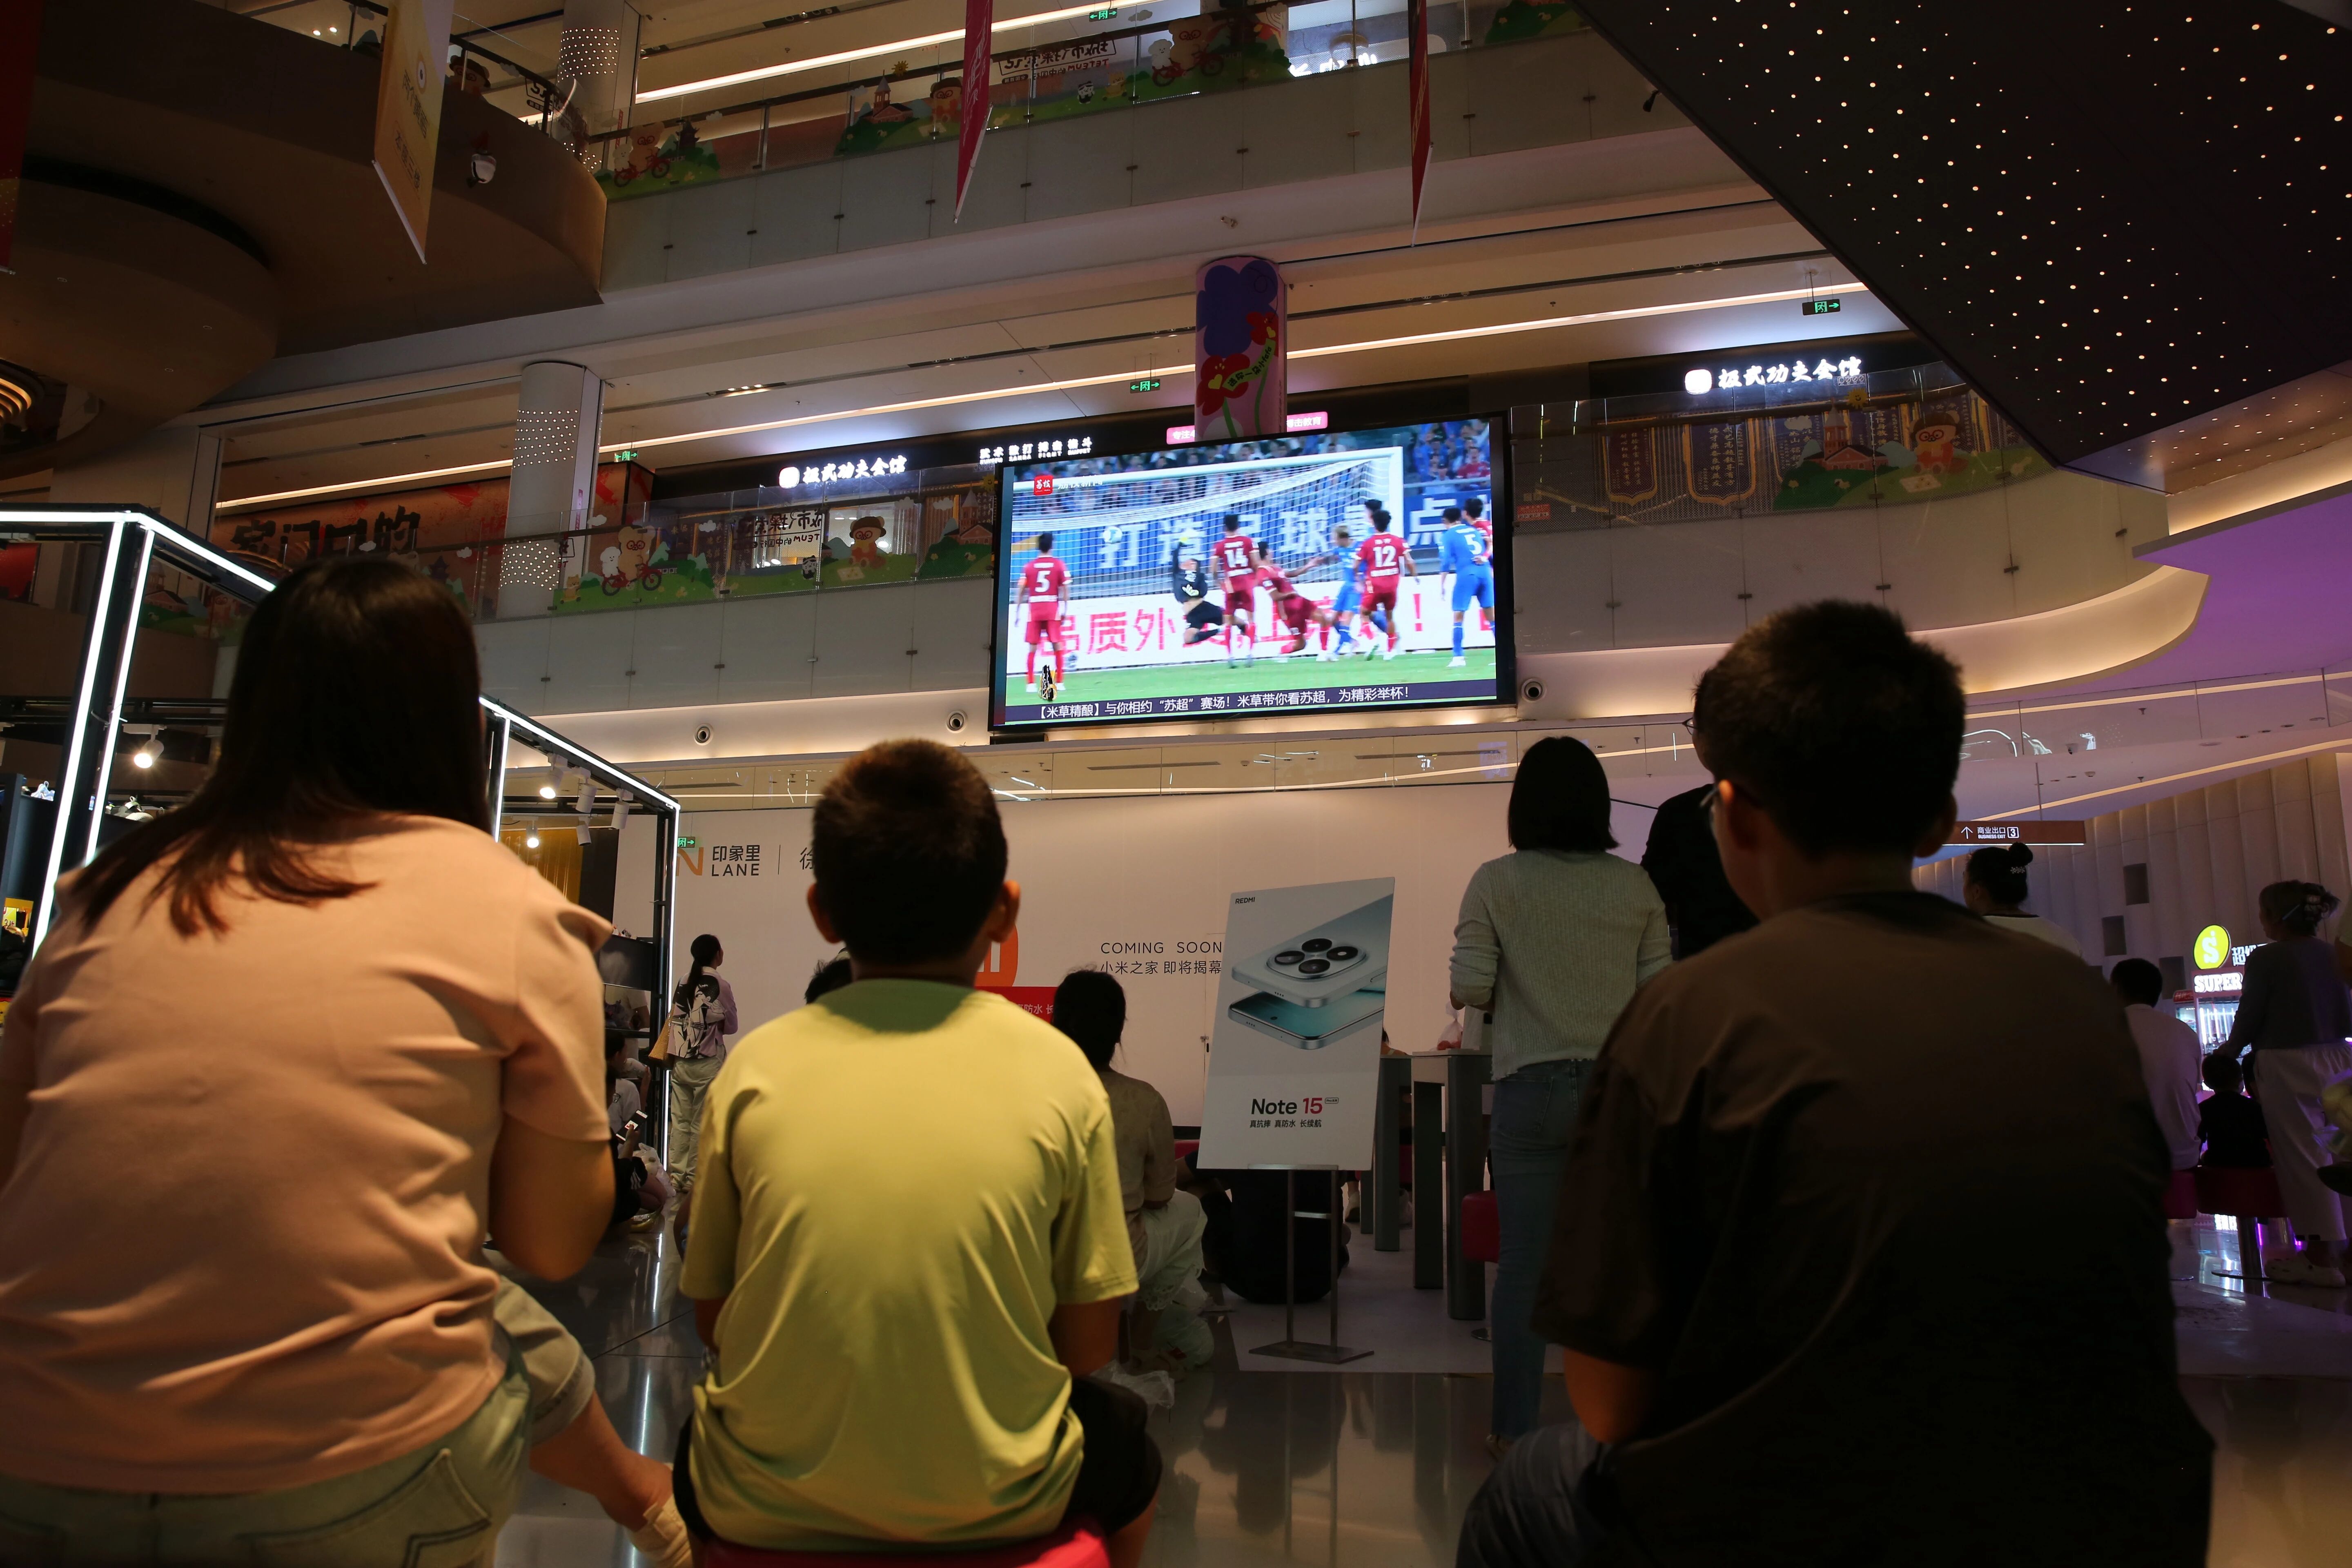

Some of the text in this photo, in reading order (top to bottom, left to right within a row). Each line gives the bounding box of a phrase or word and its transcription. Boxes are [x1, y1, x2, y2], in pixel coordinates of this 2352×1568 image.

[1036, 479, 1051, 489] 荔枝
[1465, 534, 1482, 555] 5
[1225, 548, 1248, 568] 14
[1373, 546, 1396, 568] 12
[1034, 571, 1051, 592] 5
[2010, 828, 2016, 837] 3
[713, 844, 760, 862] 印象里
[712, 863, 760, 877] LANE
[1101, 941, 1222, 954] COMING SOON
[1100, 960, 1222, 975] 小米之家 即将揭幕
[2194, 972, 2243, 993] SUPER
[1251, 1098, 1297, 1115] Note
[1303, 1098, 1323, 1114] 15
[1250, 1119, 1322, 1128] 真抗摔 真防水 长续航
